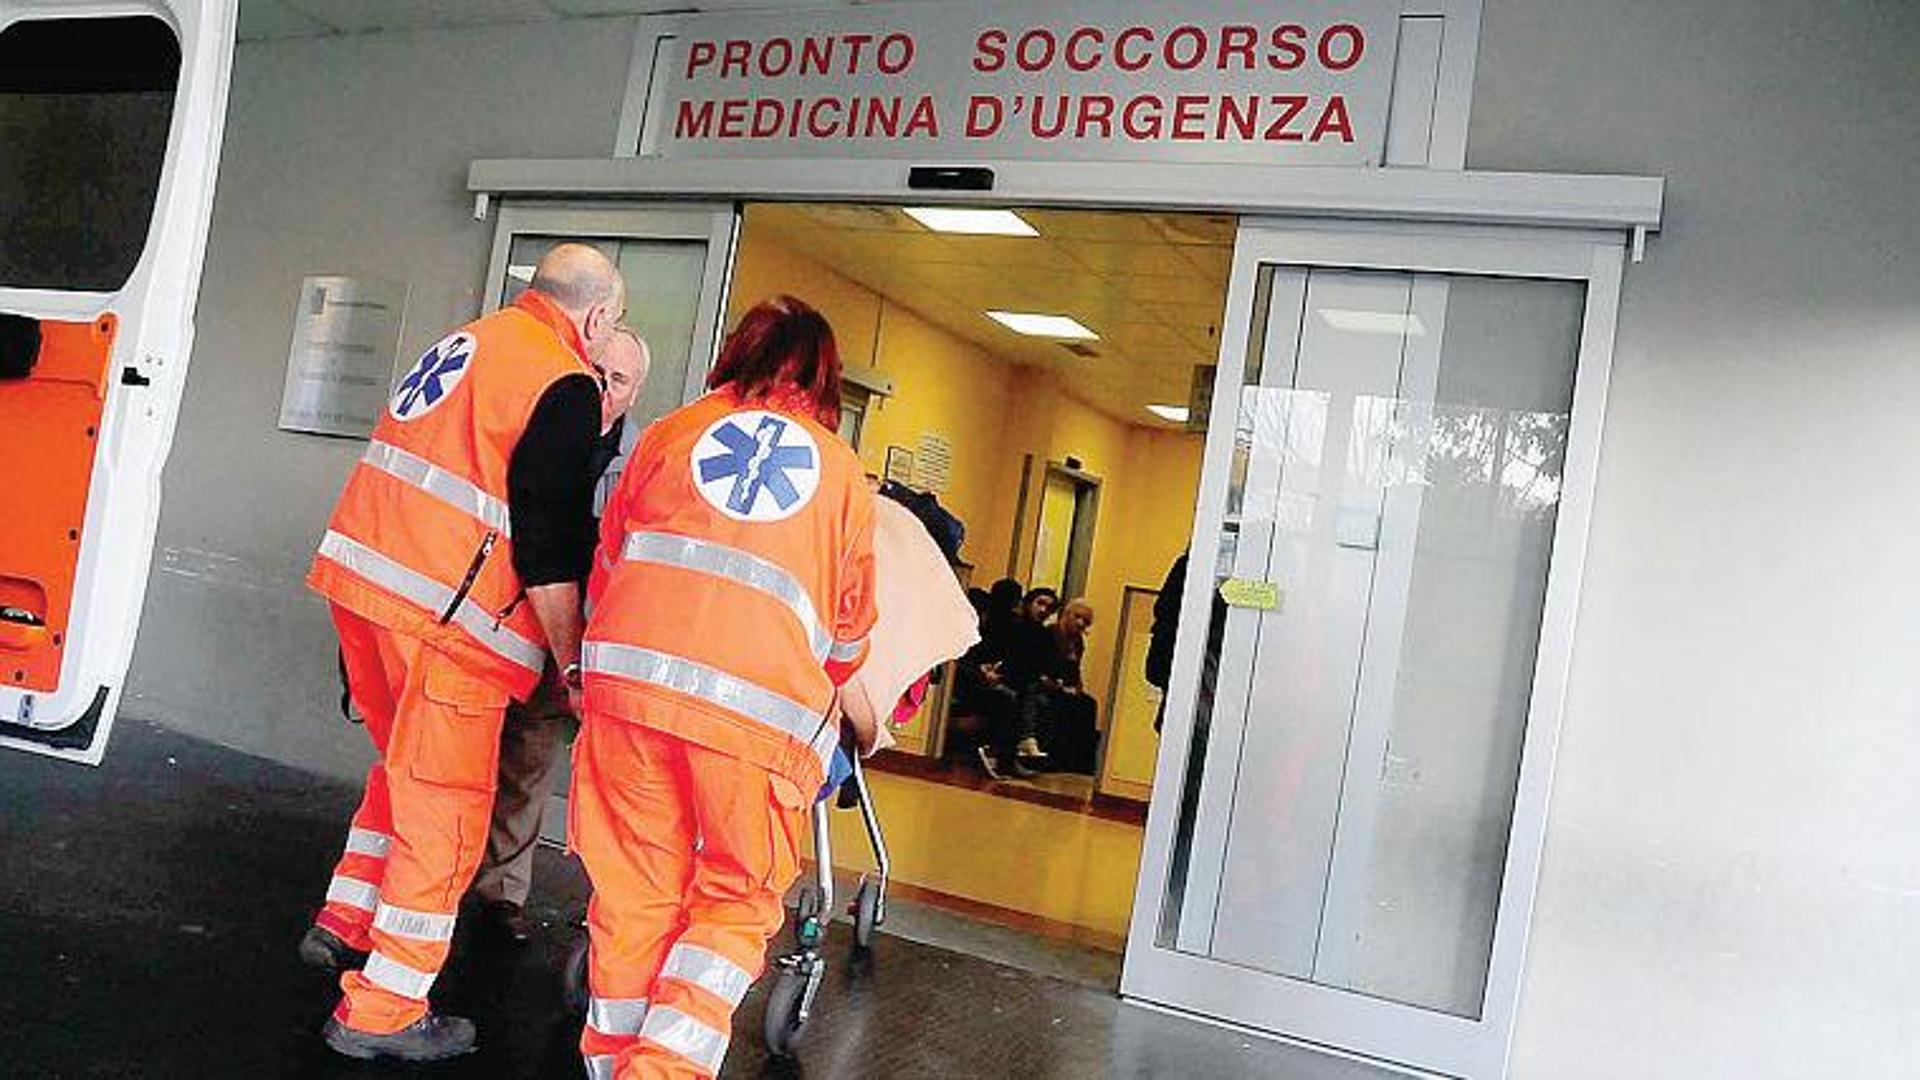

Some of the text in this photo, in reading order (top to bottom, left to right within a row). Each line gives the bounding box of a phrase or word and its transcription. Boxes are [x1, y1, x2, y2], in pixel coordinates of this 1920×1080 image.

[686, 24, 1366, 78] PRONTO SOCCORSO
[676, 94, 1354, 143] MEDICINA D'URGENZA
